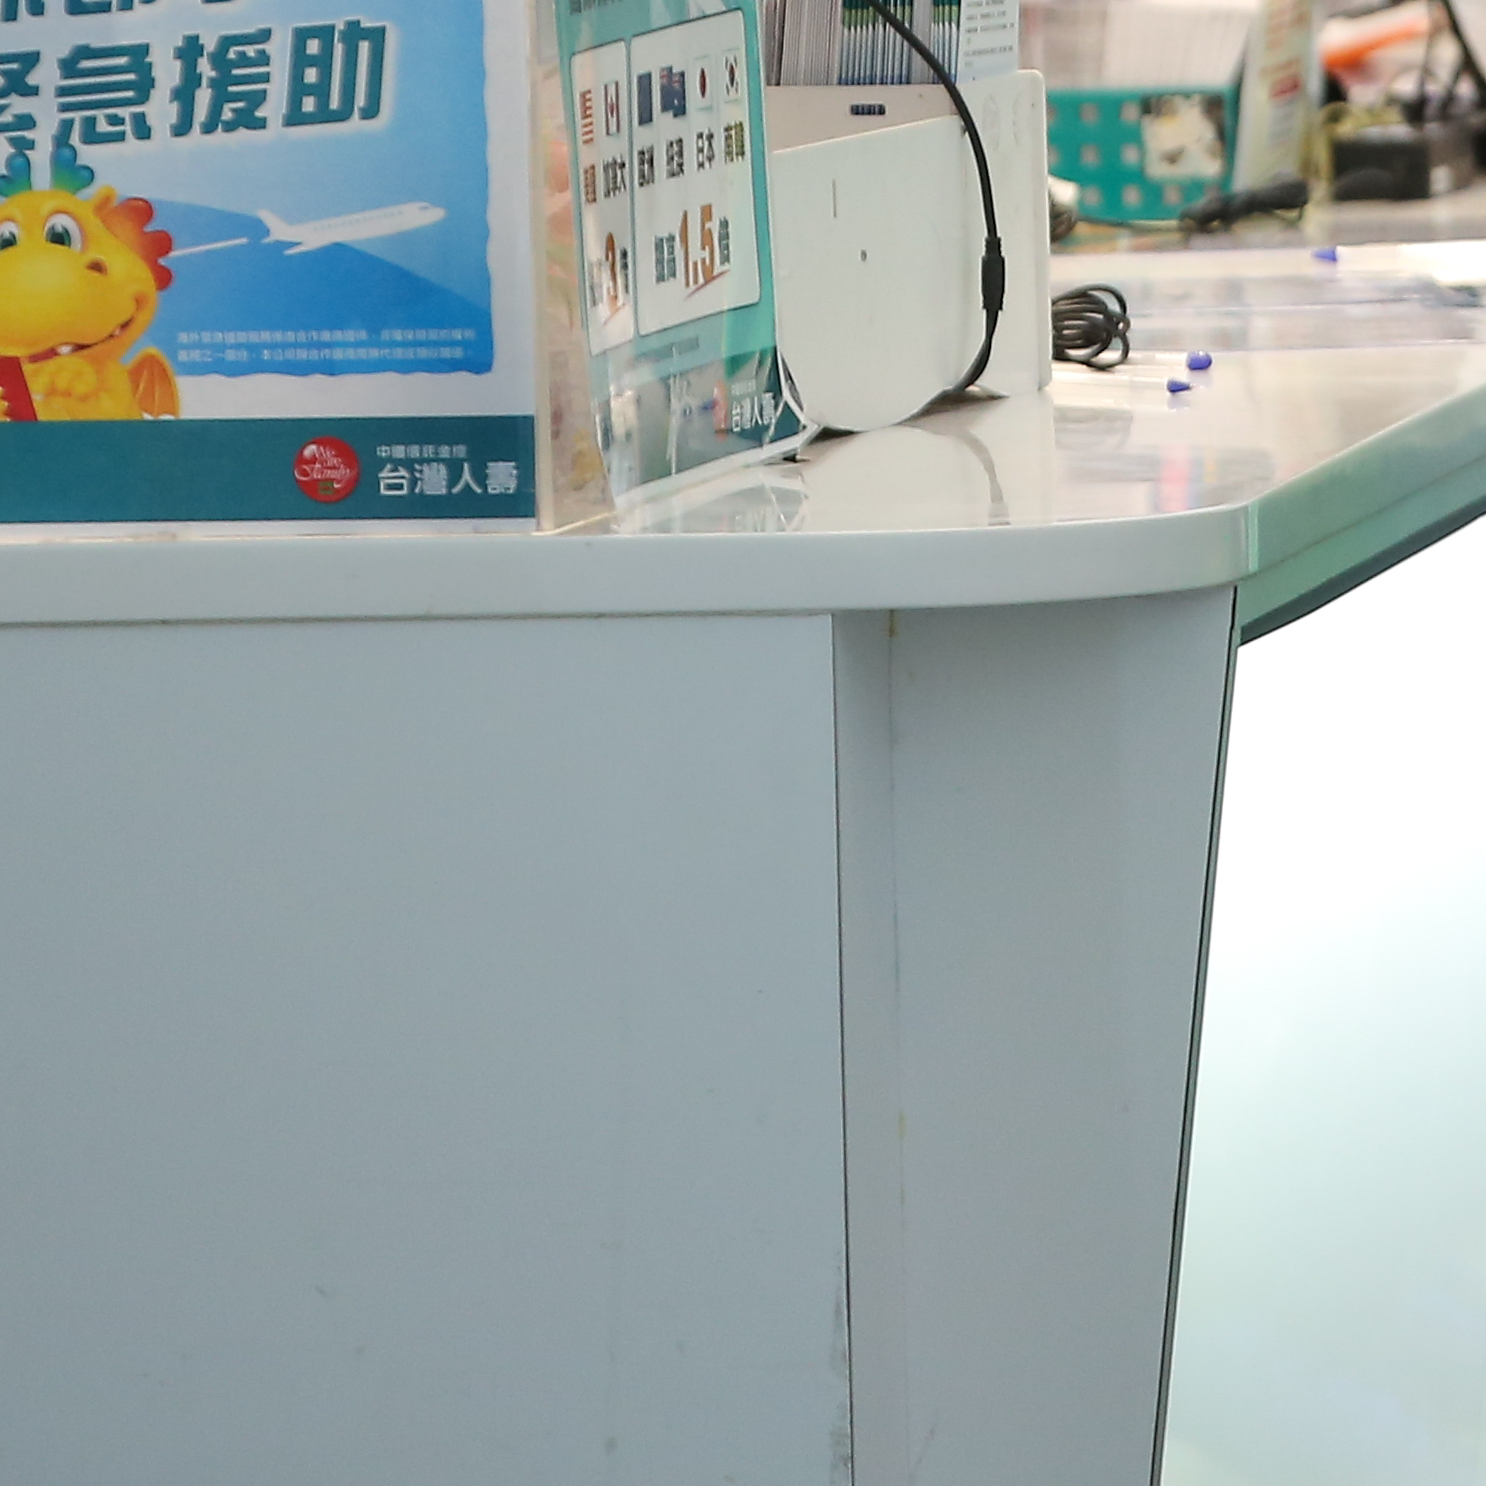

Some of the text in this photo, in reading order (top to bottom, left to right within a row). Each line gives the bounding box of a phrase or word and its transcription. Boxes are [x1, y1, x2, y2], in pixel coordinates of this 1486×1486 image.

[696, 128, 715, 171] 日本
[377, 461, 518, 496] 台灣人壽
